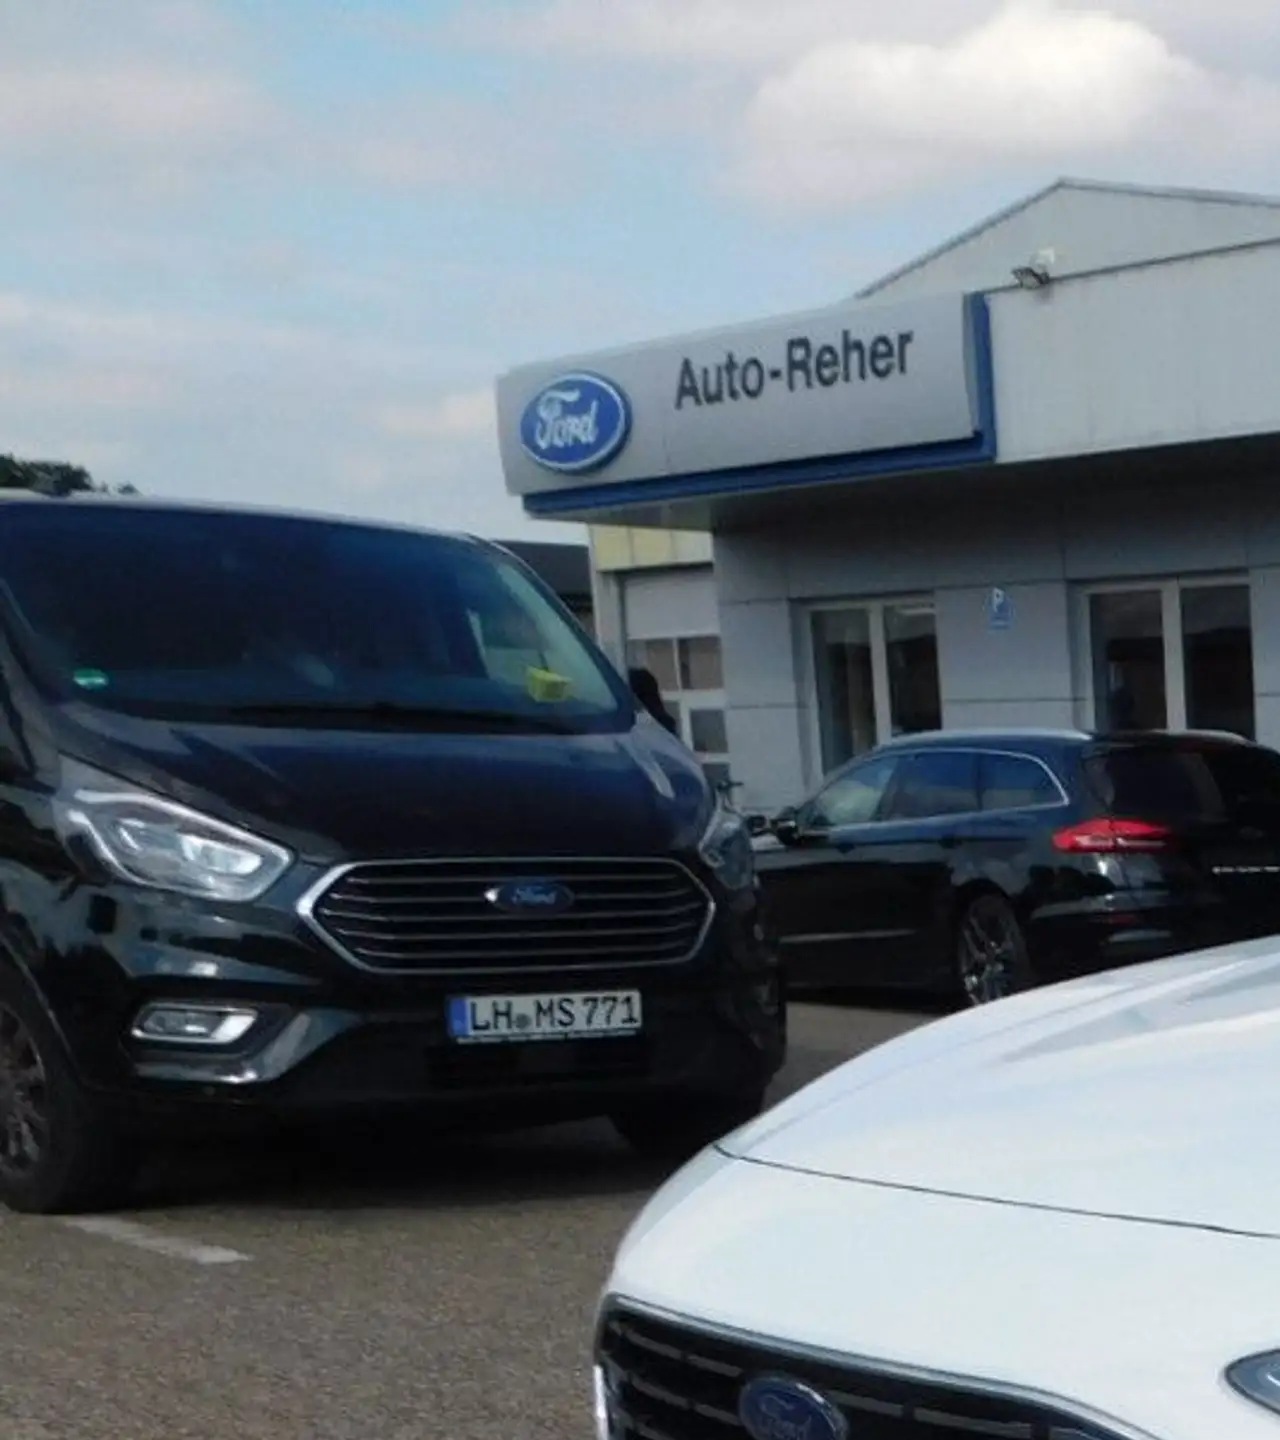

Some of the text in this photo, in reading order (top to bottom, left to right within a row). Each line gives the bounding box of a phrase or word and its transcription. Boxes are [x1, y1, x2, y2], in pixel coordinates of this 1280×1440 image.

[675, 329, 914, 411] Auto-Reher
[534, 388, 600, 451] Ford
[470, 995, 639, 1031] LH MS 771
